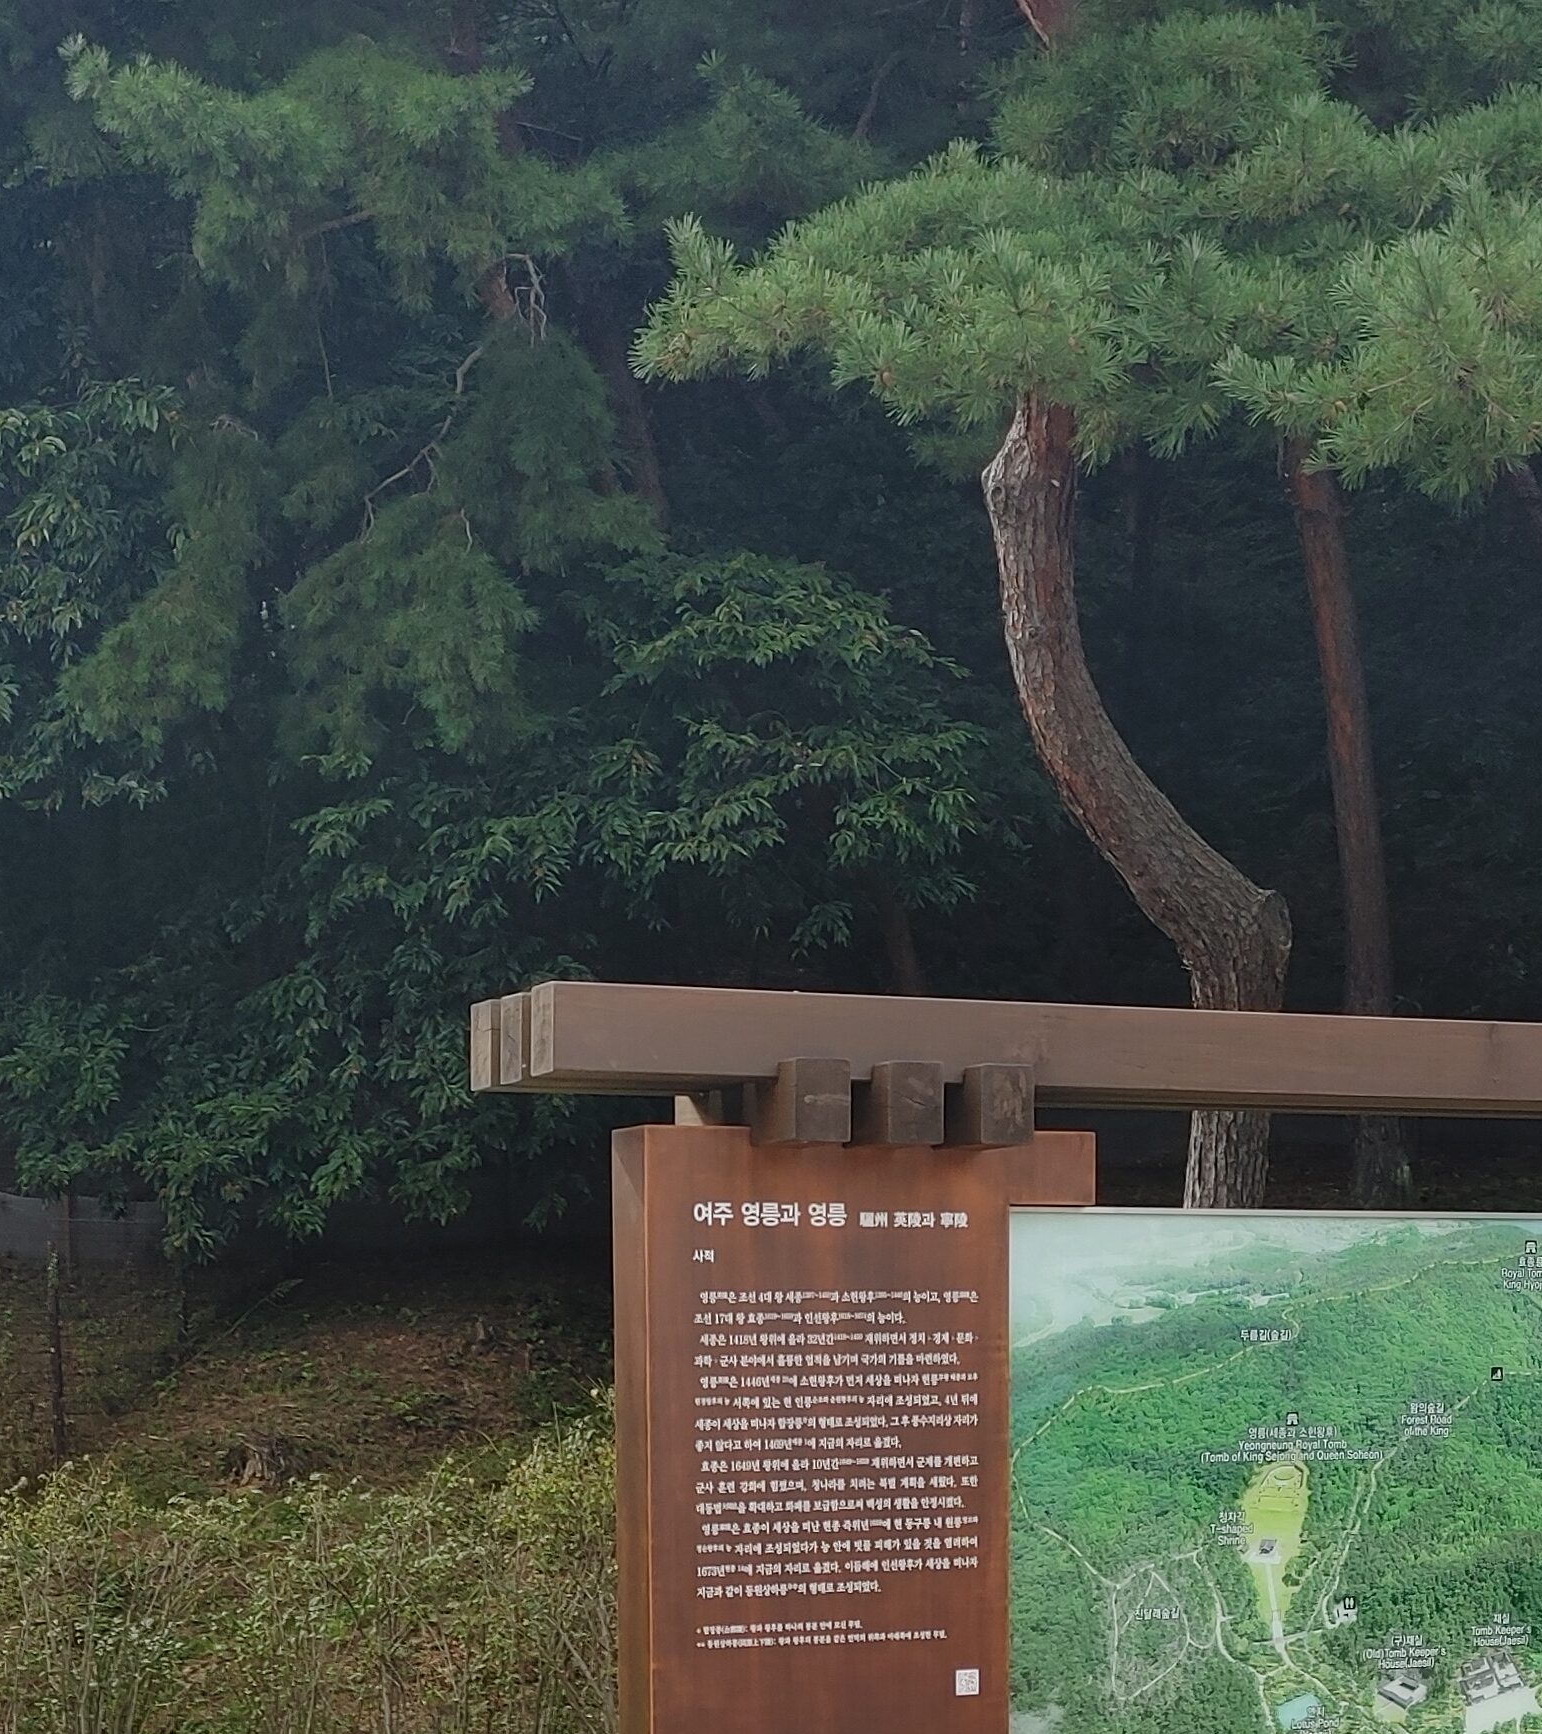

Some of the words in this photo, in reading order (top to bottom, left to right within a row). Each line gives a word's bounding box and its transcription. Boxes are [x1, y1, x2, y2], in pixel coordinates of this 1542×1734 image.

[693, 1201, 734, 1226] 여주
[741, 1202, 801, 1226] 영릉과
[808, 1202, 847, 1227] 영릉
[692, 1249, 715, 1263] 사적
[1501, 1268, 1525, 1280] Royal
[1503, 1280, 1522, 1291] King
[1401, 1414, 1428, 1425] Forest
[1430, 1414, 1453, 1425] Road
[1414, 1426, 1428, 1436] the
[1430, 1426, 1449, 1438] King
[1238, 1440, 1294, 1453] Yeongneung
[1296, 1440, 1321, 1452] Royal
[1323, 1440, 1347, 1450] Tomb
[1201, 1451, 1230, 1464] (Tomb
[1232, 1452, 1241, 1463] of
[1243, 1452, 1264, 1464] King
[1265, 1451, 1296, 1464] Sejong
[1298, 1450, 1315, 1461] and
[1317, 1450, 1345, 1462] Queen
[1347, 1449, 1383, 1461] Soheon)
[1210, 1523, 1255, 1535] T-shaped
[1217, 1535, 1246, 1546] Shrine
[1471, 1626, 1493, 1636] Tomb
[1318, 1718, 1340, 1729] Pond
